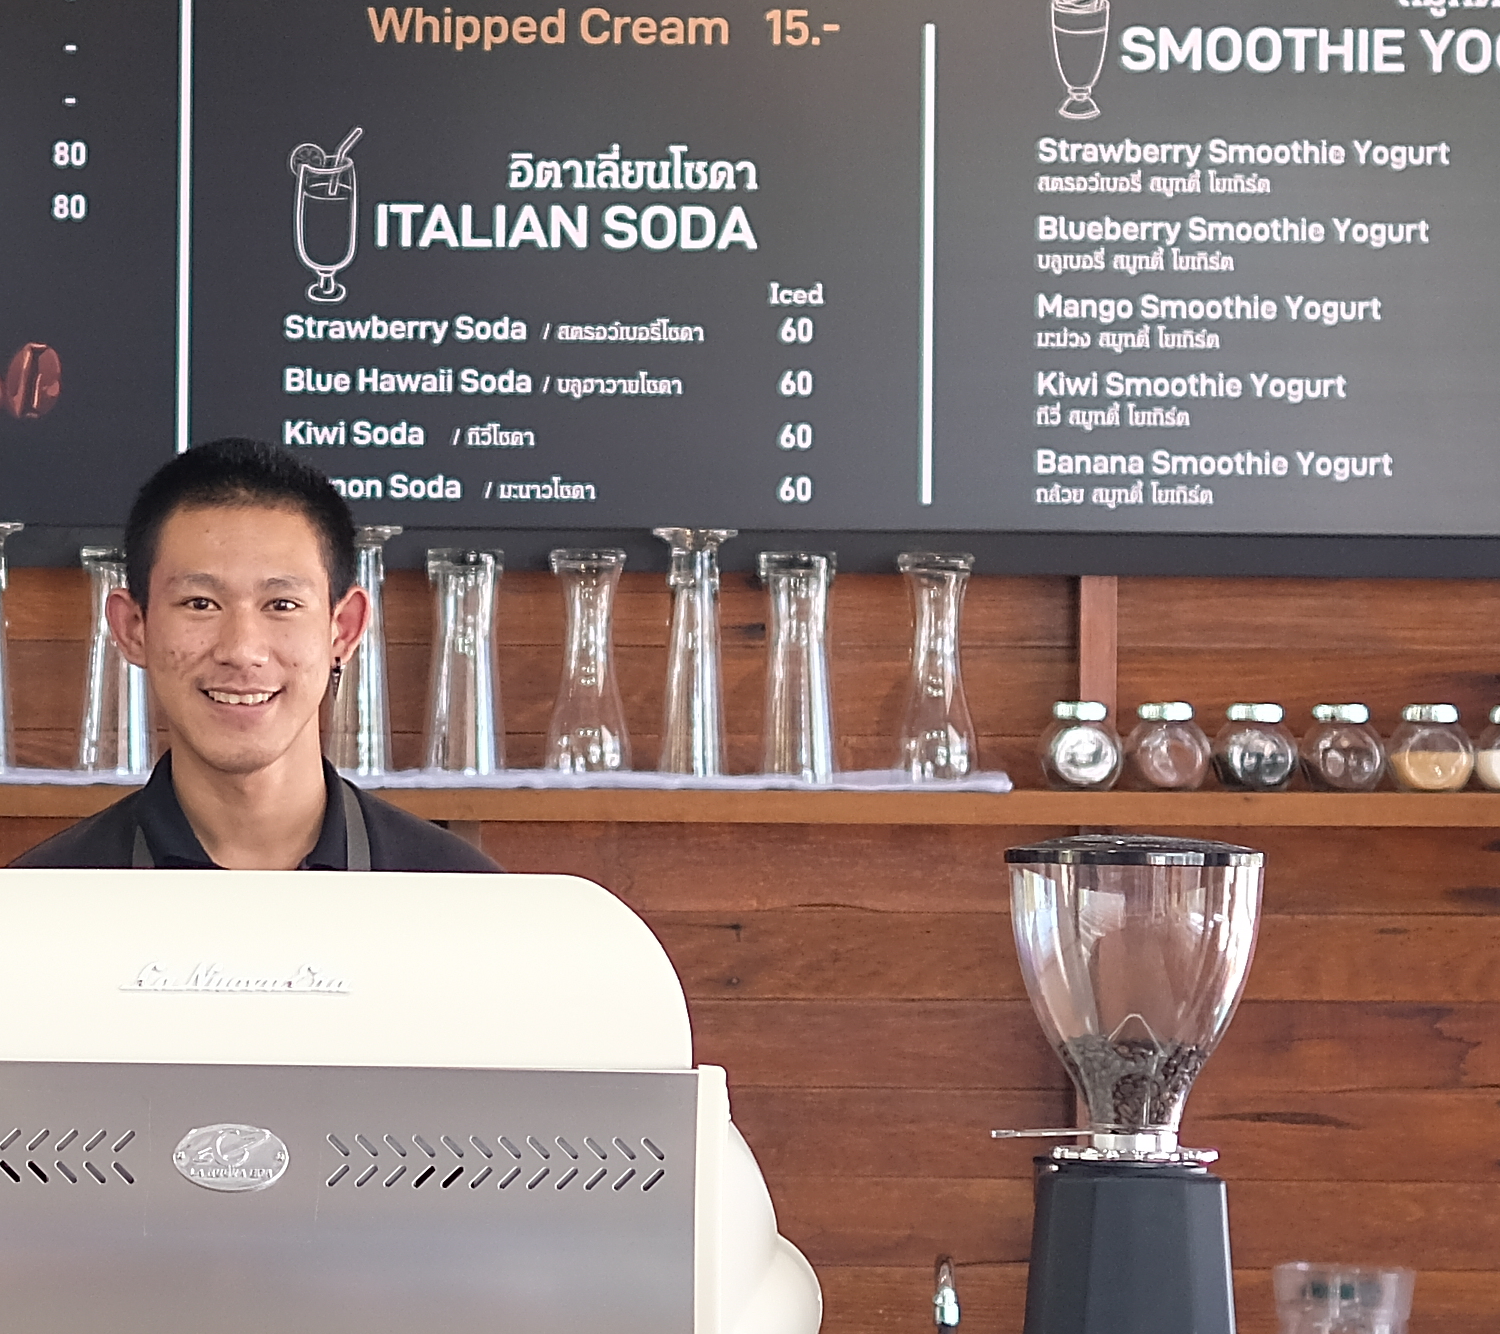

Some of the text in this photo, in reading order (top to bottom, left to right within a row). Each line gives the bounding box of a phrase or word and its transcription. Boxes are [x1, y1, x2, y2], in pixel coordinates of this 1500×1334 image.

[367, 7, 841, 51] Whipped Cream 15.-
[1121, 26, 1406, 73] SMOOTHIE
[53, 141, 86, 167] 80
[508, 143, 758, 191] อิตาเลี่ยนโซดา
[1038, 137, 1202, 169] Strawberry
[1208, 138, 1346, 165] Smoothie
[1352, 139, 1451, 170] Yogurt
[53, 194, 86, 219] 80
[376, 203, 758, 250] ITALIAN SODA
[1038, 215, 1182, 246] Blueberry
[1188, 216, 1325, 243] Smoothie
[1331, 217, 1430, 248] Yogurt
[769, 282, 824, 305] Iced
[1037, 293, 1134, 324] Mango
[1140, 293, 1278, 320] Smoothie
[1284, 295, 1382, 326] Yogurt
[285, 314, 813, 344] Strawberry Soda 60
[285, 366, 813, 396] Blue Hawaii Soda 60
[1037, 371, 1098, 397] Kiwi
[1105, 371, 1243, 398] Smoothie
[1249, 373, 1347, 404] Yogurt
[284, 420, 812, 449] Kiwi Soda 60
[1036, 449, 1144, 475] Banana
[1151, 449, 1289, 476] Smoothie
[1295, 451, 1393, 481] Yogurt
[389, 473, 461, 499] Soda
[779, 476, 812, 502] 60
